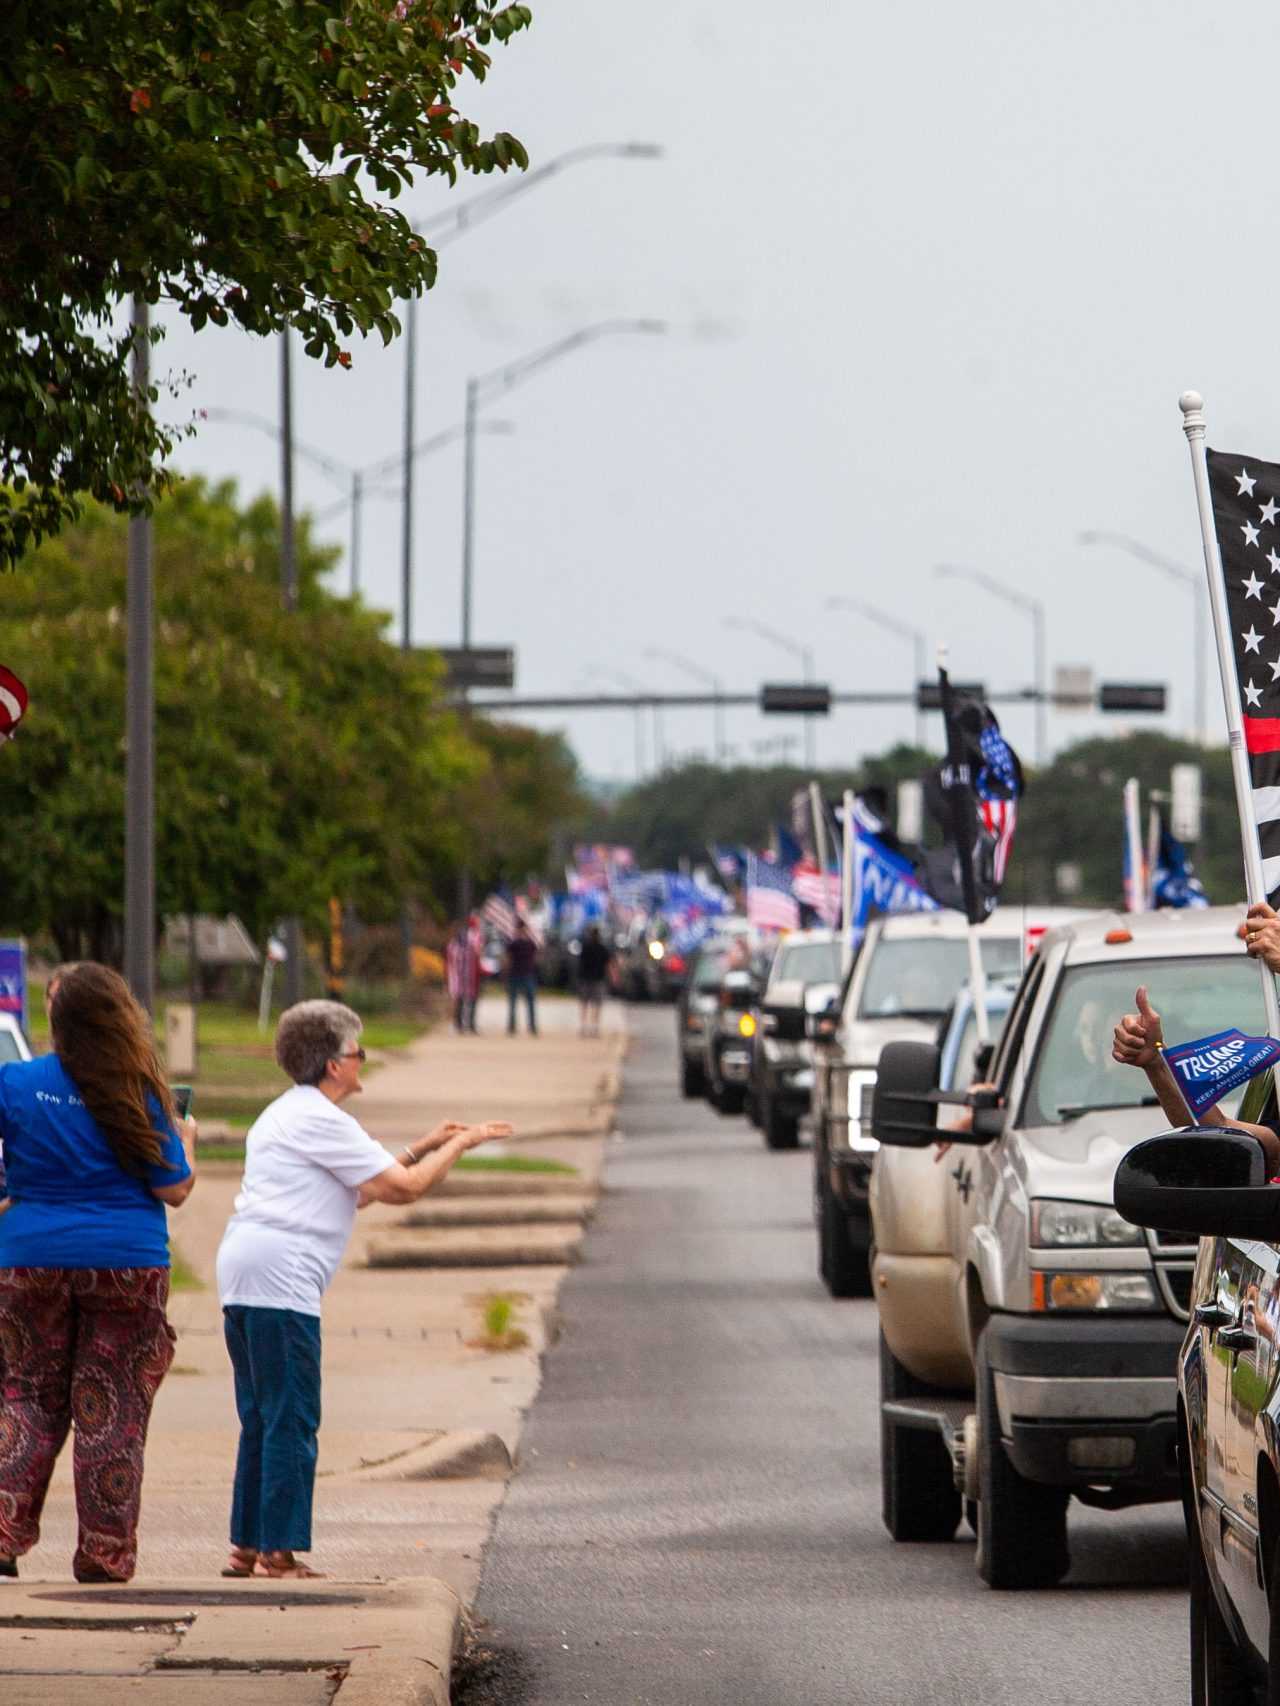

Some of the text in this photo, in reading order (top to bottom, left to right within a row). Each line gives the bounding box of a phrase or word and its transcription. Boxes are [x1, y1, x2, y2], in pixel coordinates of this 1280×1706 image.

[1175, 1039, 1246, 1081] TRUMP
[1195, 1088, 1216, 1106] KEEP
[1216, 1066, 1250, 1092] AMERICA
